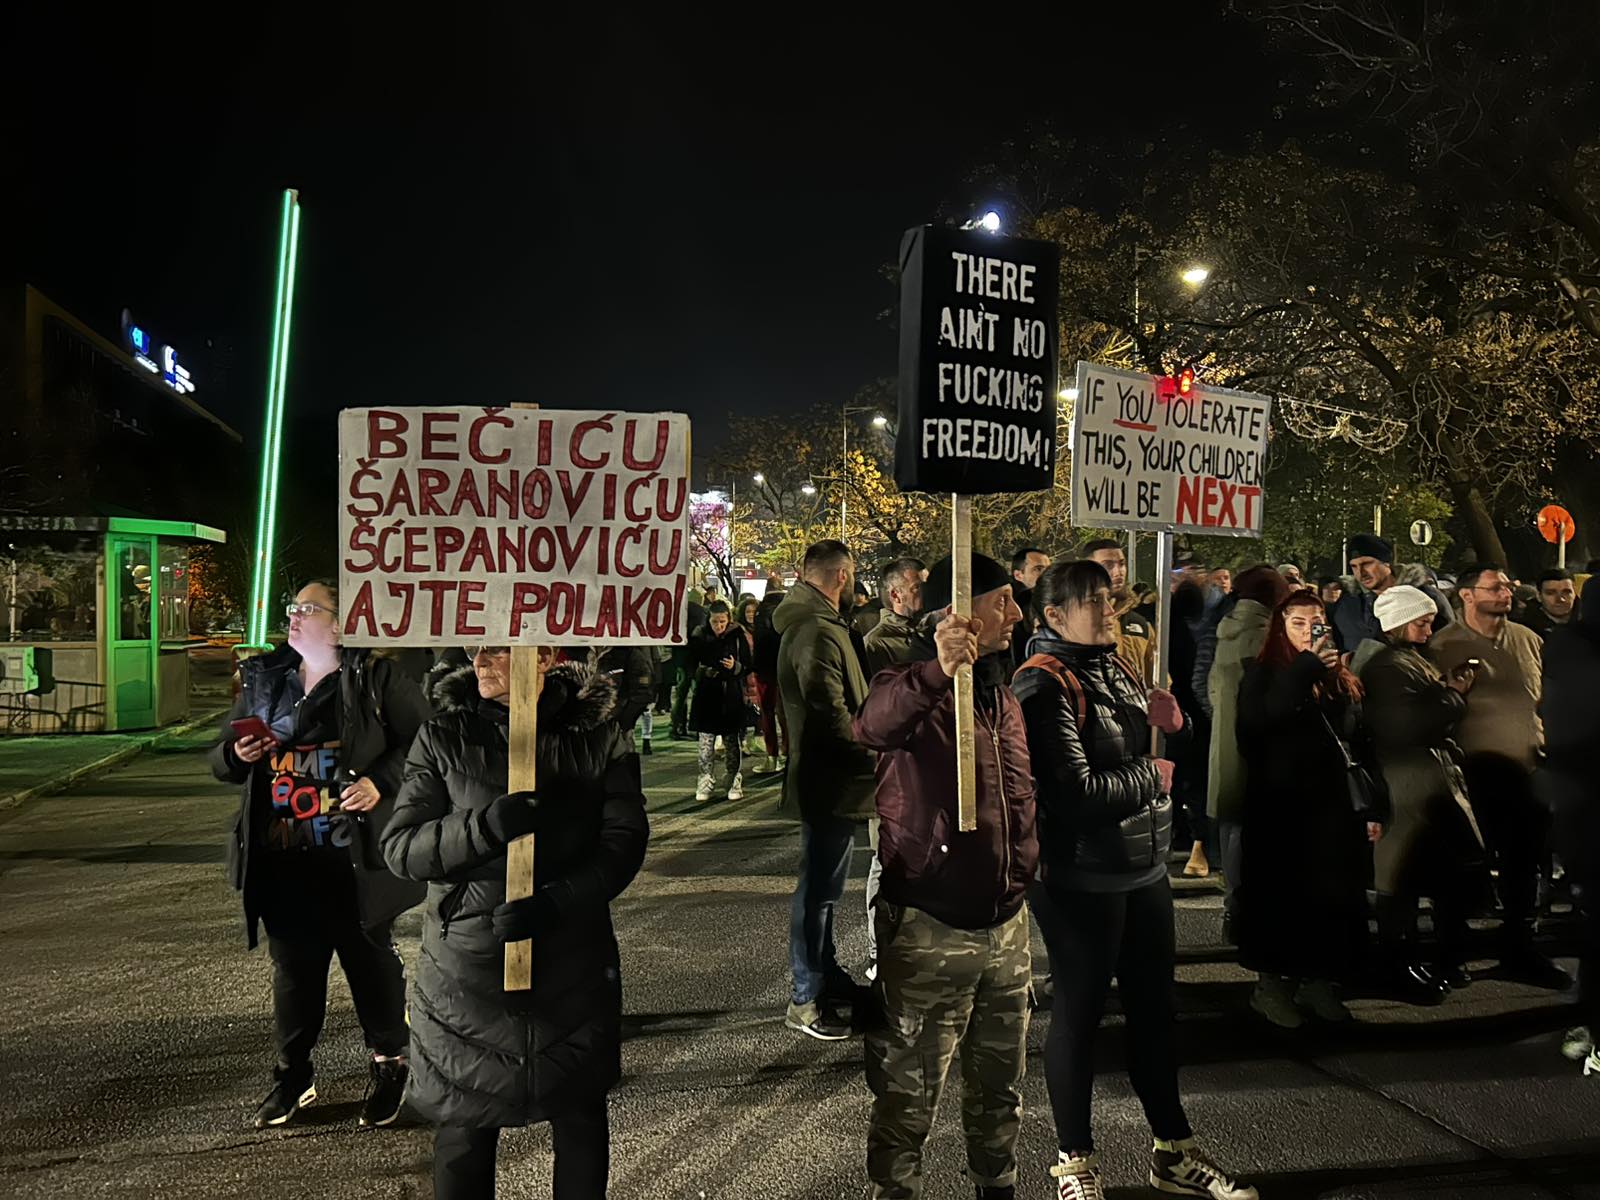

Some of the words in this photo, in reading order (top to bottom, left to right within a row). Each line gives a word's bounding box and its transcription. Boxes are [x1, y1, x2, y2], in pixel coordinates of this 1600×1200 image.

[952, 251, 1036, 304] THERE
[1012, 317, 1046, 359] NO
[938, 363, 1043, 413] FUCKING
[1085, 377, 1105, 415] IF
[1116, 382, 1154, 424] YOU
[1162, 392, 1264, 441] TOLERATE
[367, 407, 669, 471] BEČIĆU
[922, 418, 1050, 471] FREEDOM!
[1081, 430, 1132, 476] THIS,
[1138, 434, 1185, 475] YOUR
[346, 457, 686, 522] ŠARANOVIĆU
[1084, 476, 1129, 515] WILL
[1137, 480, 1161, 518] BE
[1175, 475, 1261, 529] NEXT
[344, 517, 683, 577] ŠĆEPANOVIĆU
[343, 580, 487, 637] AJTE
[508, 574, 687, 644] POLAKO!
